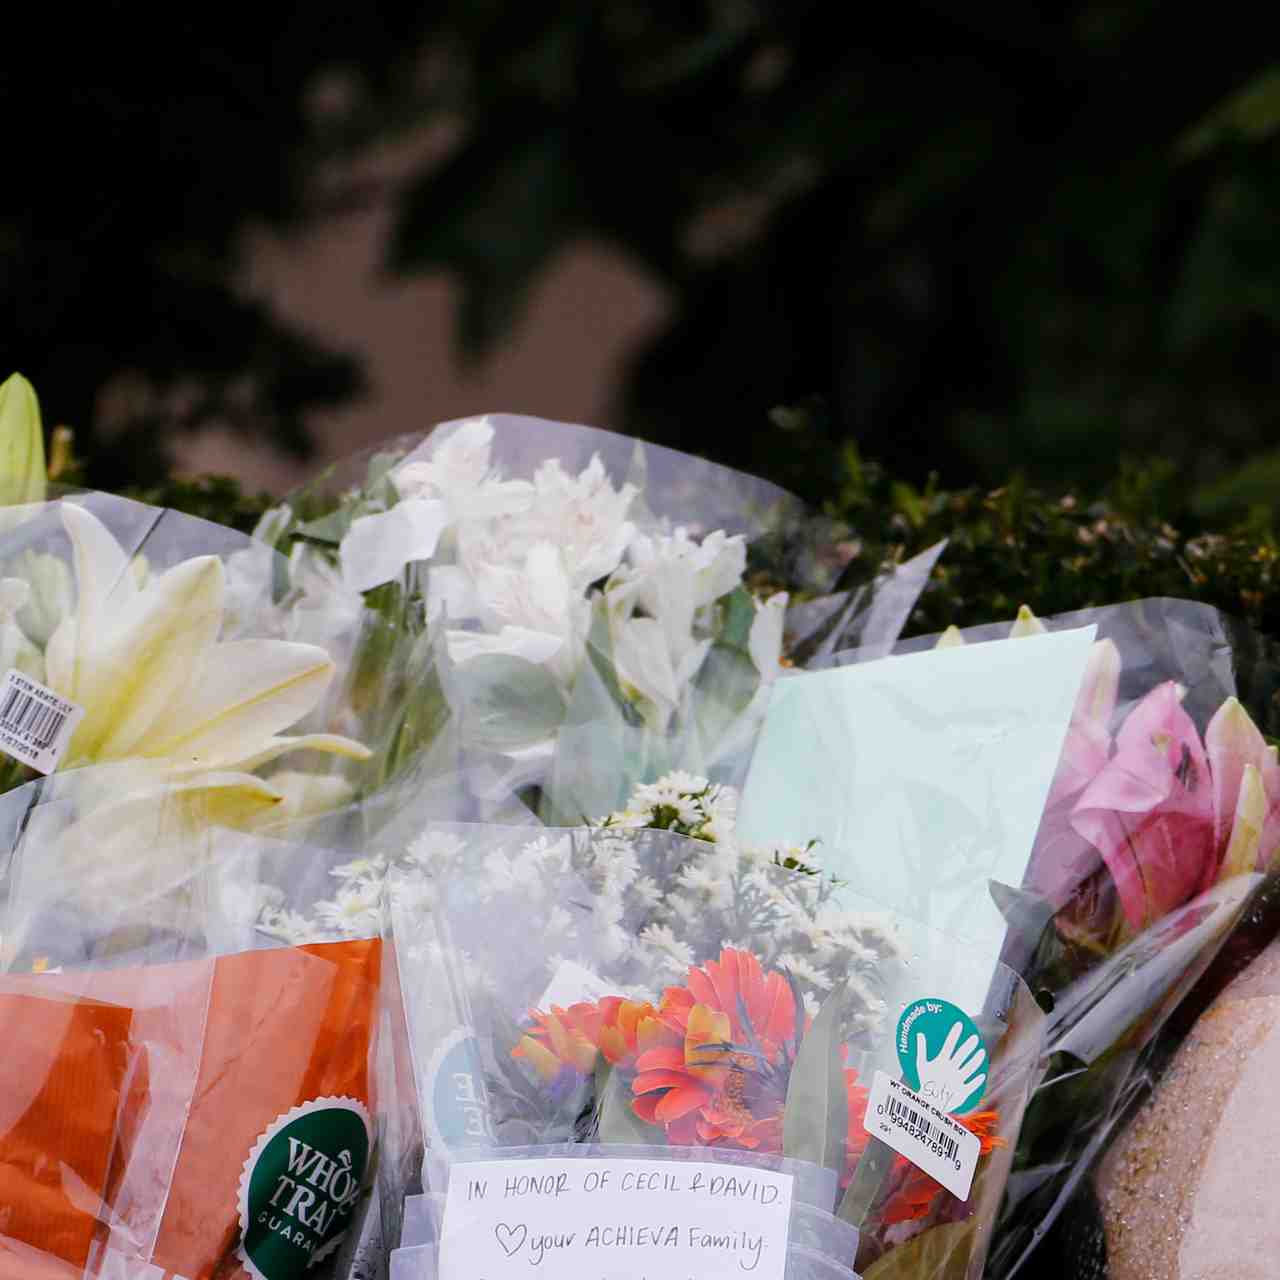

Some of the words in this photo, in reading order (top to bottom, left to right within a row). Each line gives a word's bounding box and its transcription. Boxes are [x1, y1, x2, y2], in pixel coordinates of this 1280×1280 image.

[899, 1005, 926, 1053] Handmade
[901, 1087, 931, 1111] ORANGE
[930, 1106, 953, 1127] CRUSH
[468, 1180, 488, 1200] IN
[504, 1172, 571, 1198] HONOR
[583, 1170, 612, 1192] OF
[621, 1172, 680, 1191] CECIL
[528, 1232, 576, 1266] your
[585, 1225, 679, 1247] ACHIEVA
